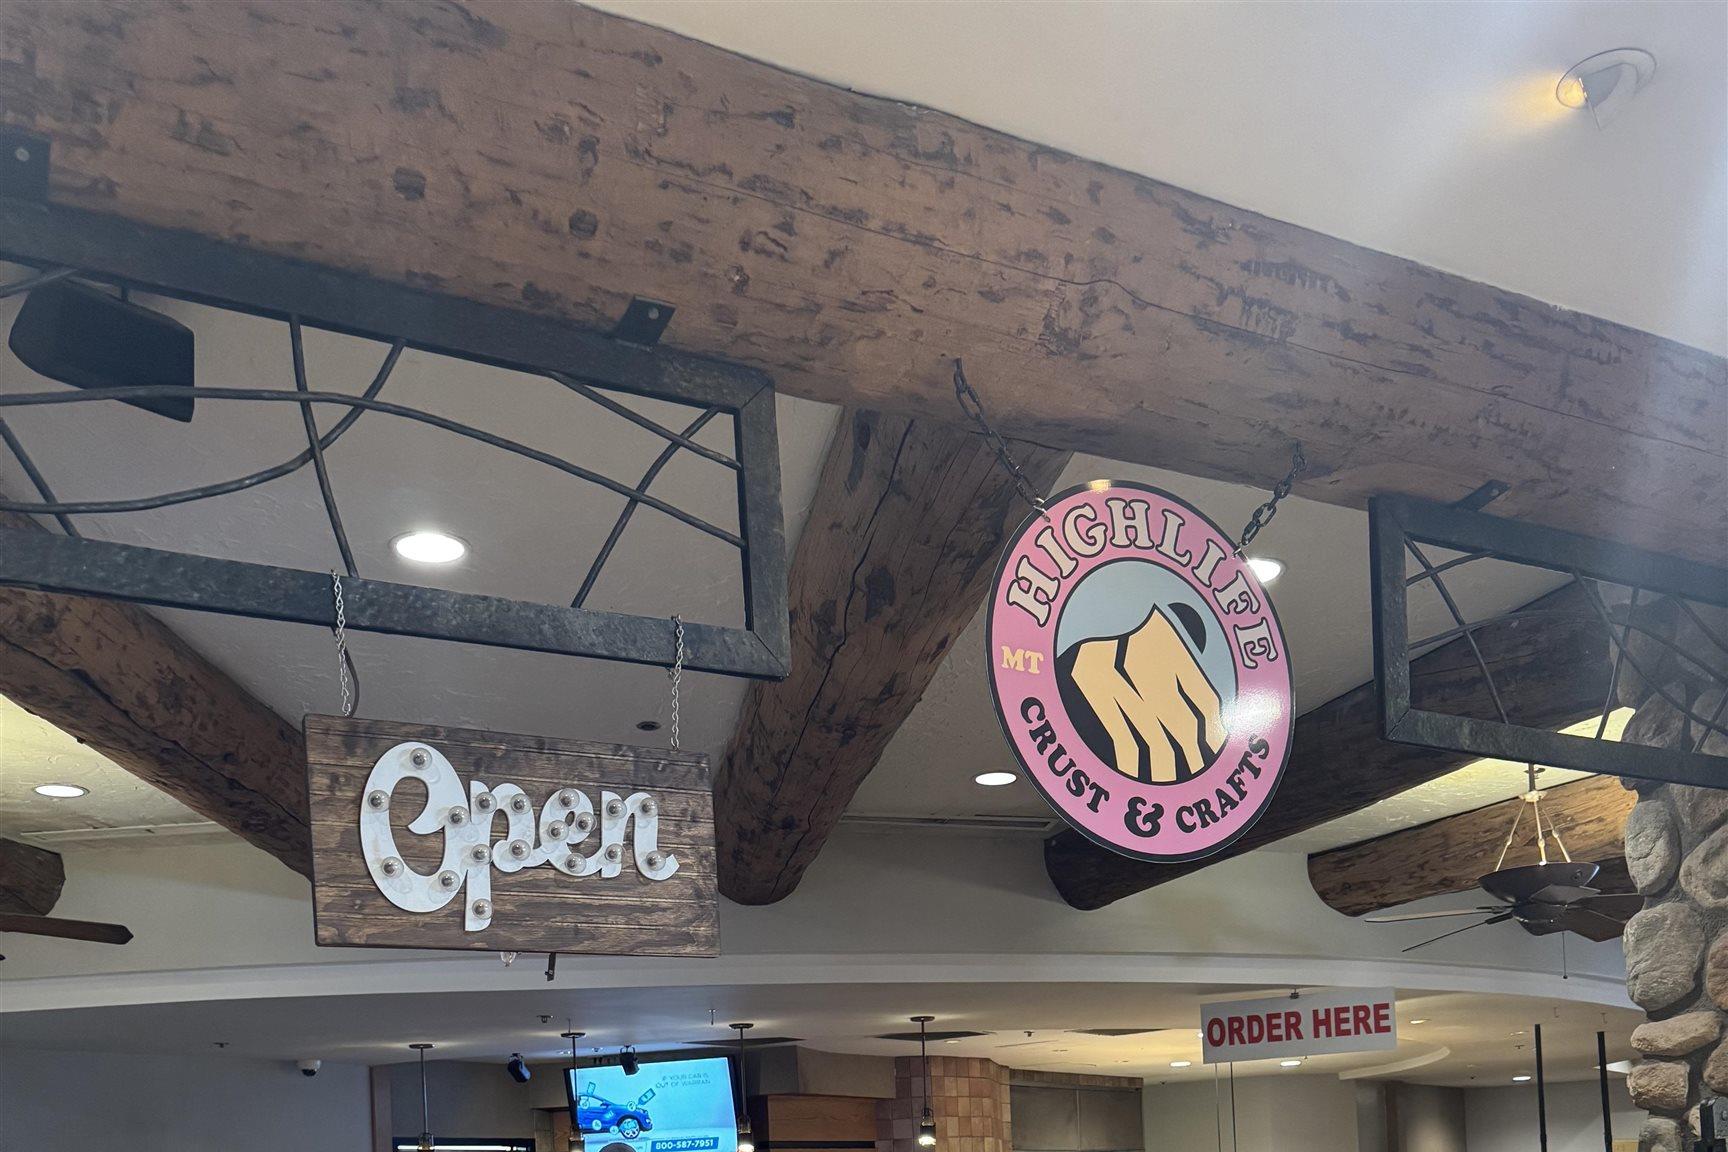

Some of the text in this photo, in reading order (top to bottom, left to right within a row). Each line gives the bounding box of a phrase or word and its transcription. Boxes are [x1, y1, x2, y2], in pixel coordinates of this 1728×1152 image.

[1006, 498, 1278, 670] HIGHLIFE
[1000, 646, 1044, 674] MT
[360, 741, 680, 932] Open
[1020, 697, 1270, 838] CRUST & CRAFTS
[1207, 1002, 1392, 1048] ORDER HERE
